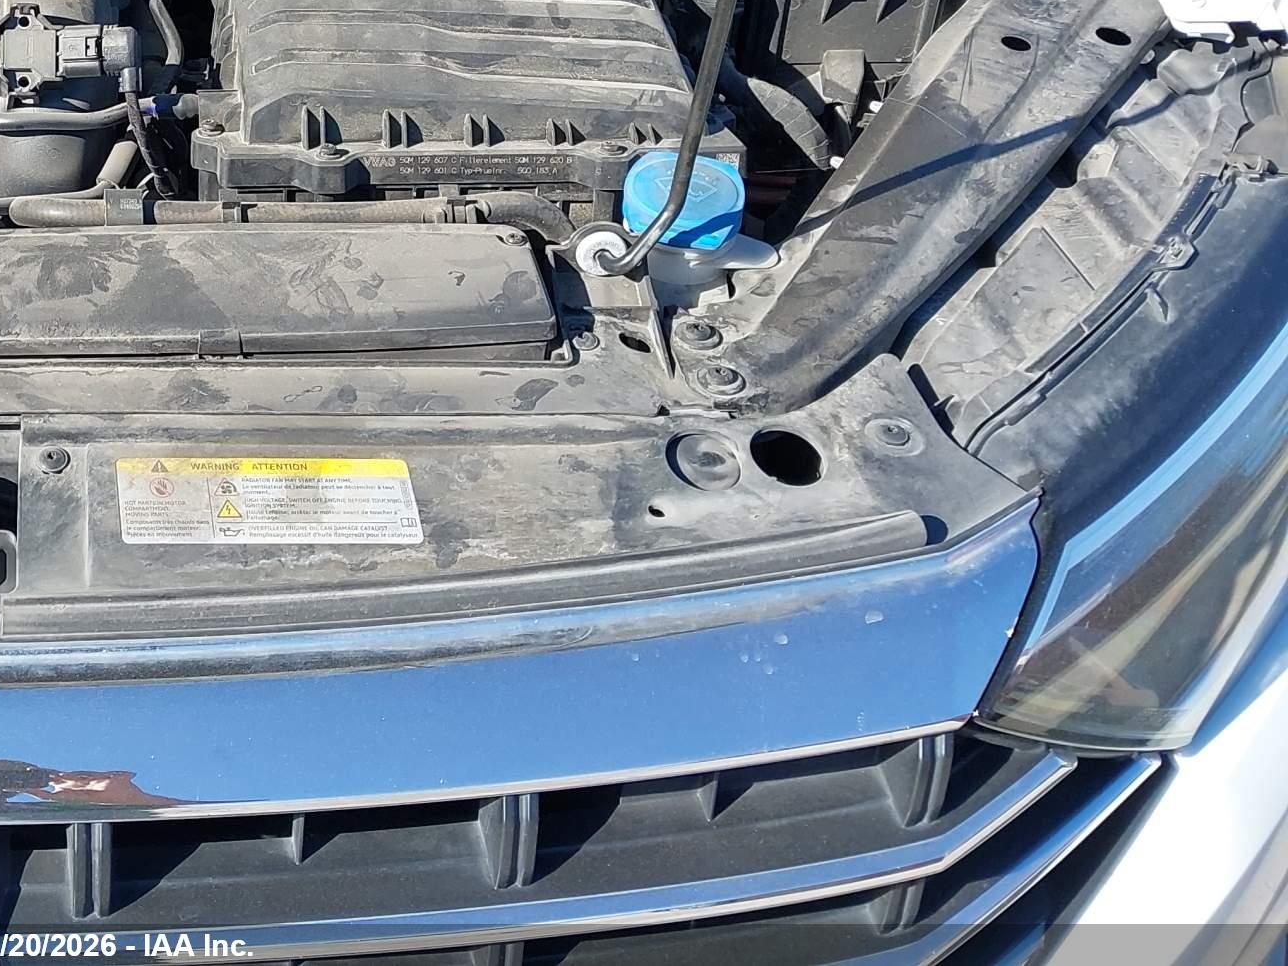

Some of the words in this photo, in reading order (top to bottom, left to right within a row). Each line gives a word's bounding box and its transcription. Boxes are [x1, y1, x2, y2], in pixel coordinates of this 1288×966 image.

[417, 156, 431, 164] 129
[434, 156, 448, 164] 607
[532, 155, 546, 164] 129
[417, 167, 431, 175] 129
[190, 463, 240, 471] WARNING
[251, 463, 308, 471] ATTENTION
